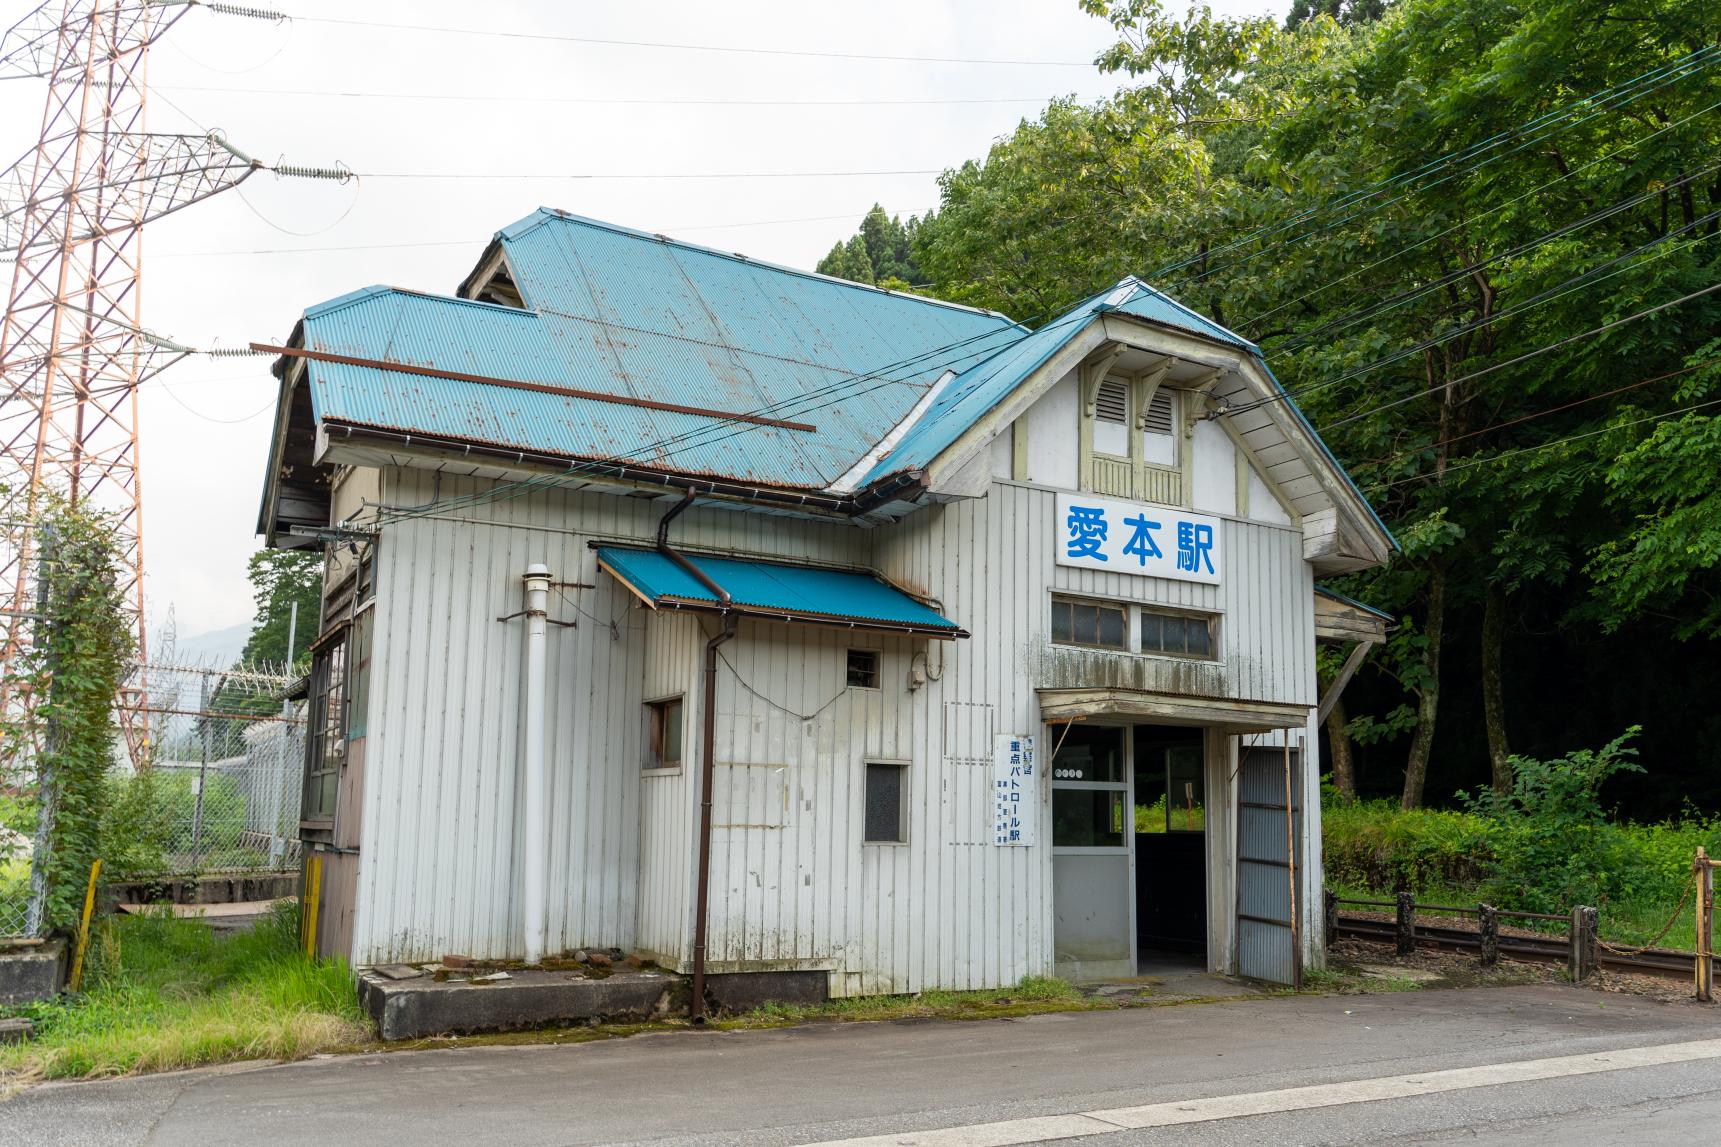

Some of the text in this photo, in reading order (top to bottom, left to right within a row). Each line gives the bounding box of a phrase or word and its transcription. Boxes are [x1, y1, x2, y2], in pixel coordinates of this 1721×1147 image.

[1067, 505, 1215, 575] 愛本駅
[1010, 740, 1021, 841] 重点パトロール駅
